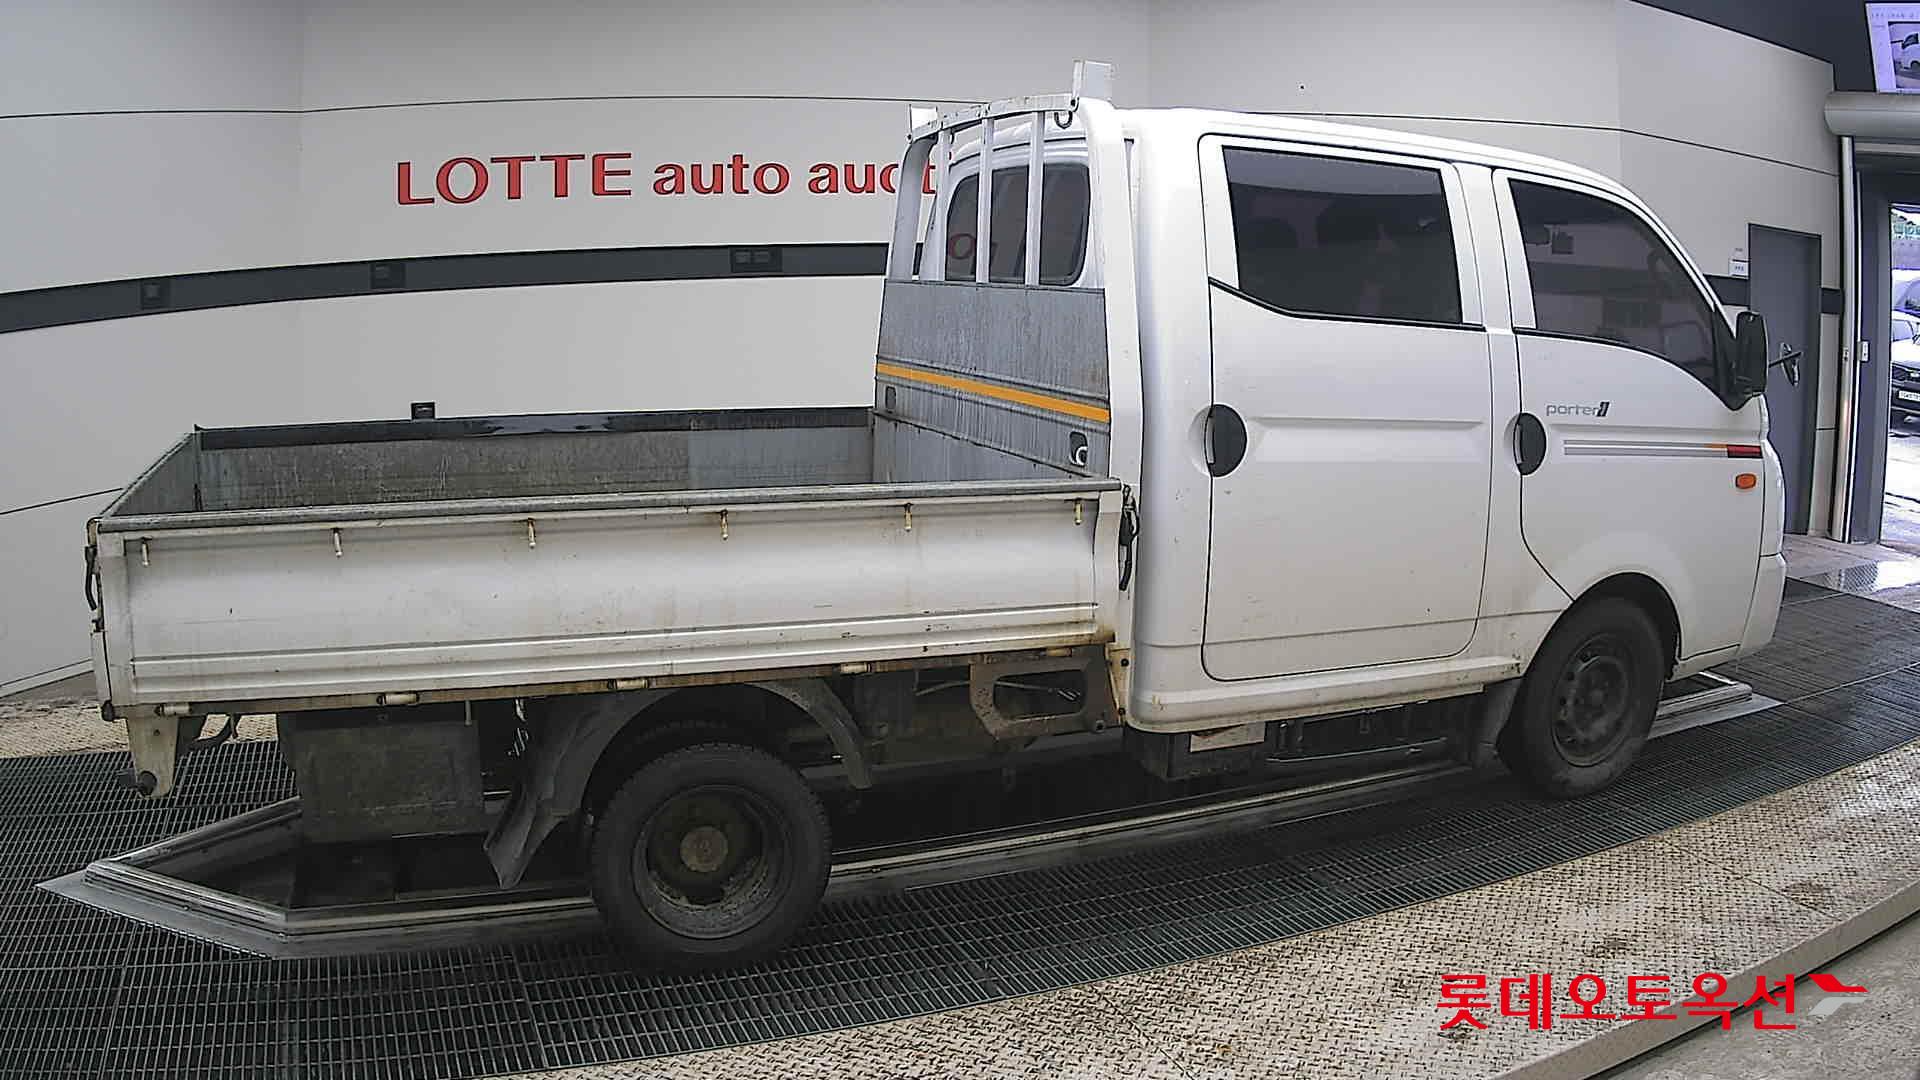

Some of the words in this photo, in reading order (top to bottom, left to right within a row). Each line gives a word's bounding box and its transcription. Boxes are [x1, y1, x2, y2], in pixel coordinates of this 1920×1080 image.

[398, 152, 631, 205] LOTTE
[653, 154, 790, 195] auto
[1546, 404, 1599, 417] porter
